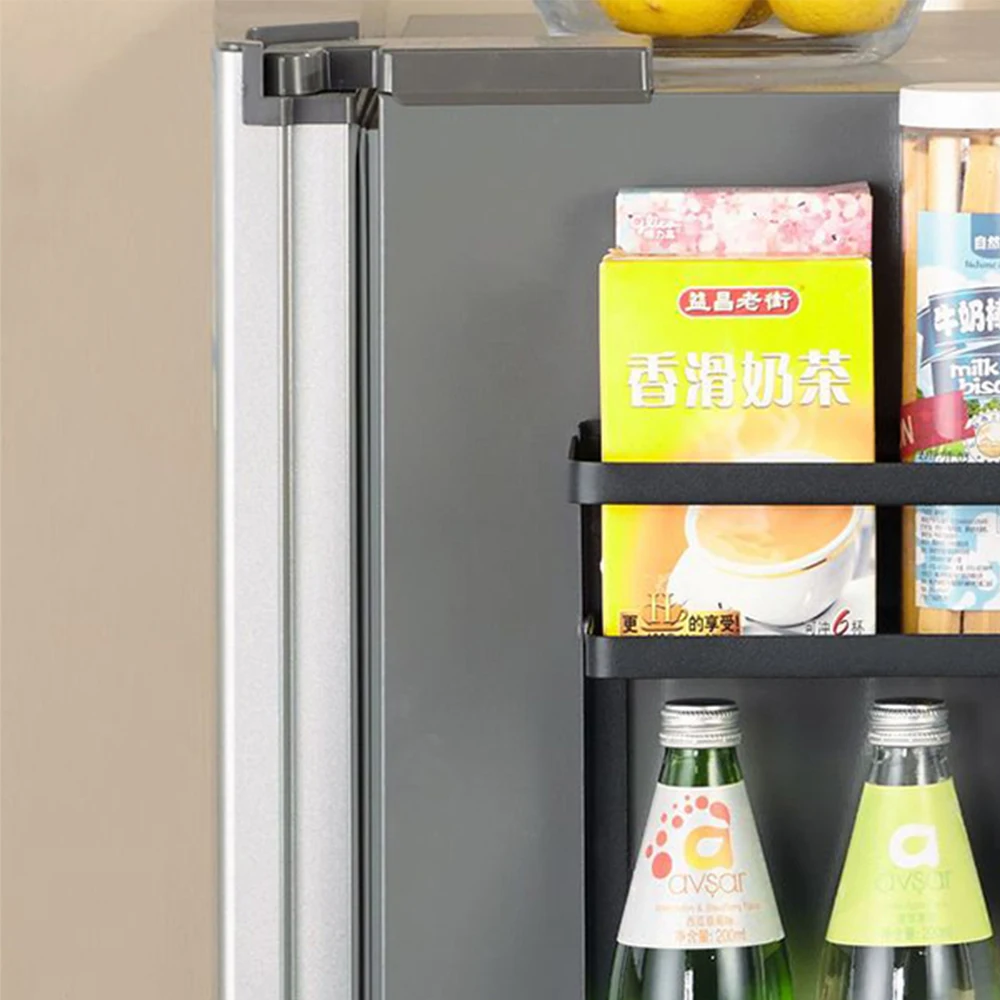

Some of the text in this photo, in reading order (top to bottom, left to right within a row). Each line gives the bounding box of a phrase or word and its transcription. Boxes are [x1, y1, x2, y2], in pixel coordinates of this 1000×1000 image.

[684, 291, 793, 313] 益昌老街
[950, 357, 1000, 378] milk
[626, 350, 851, 409] 香滑奶茶
